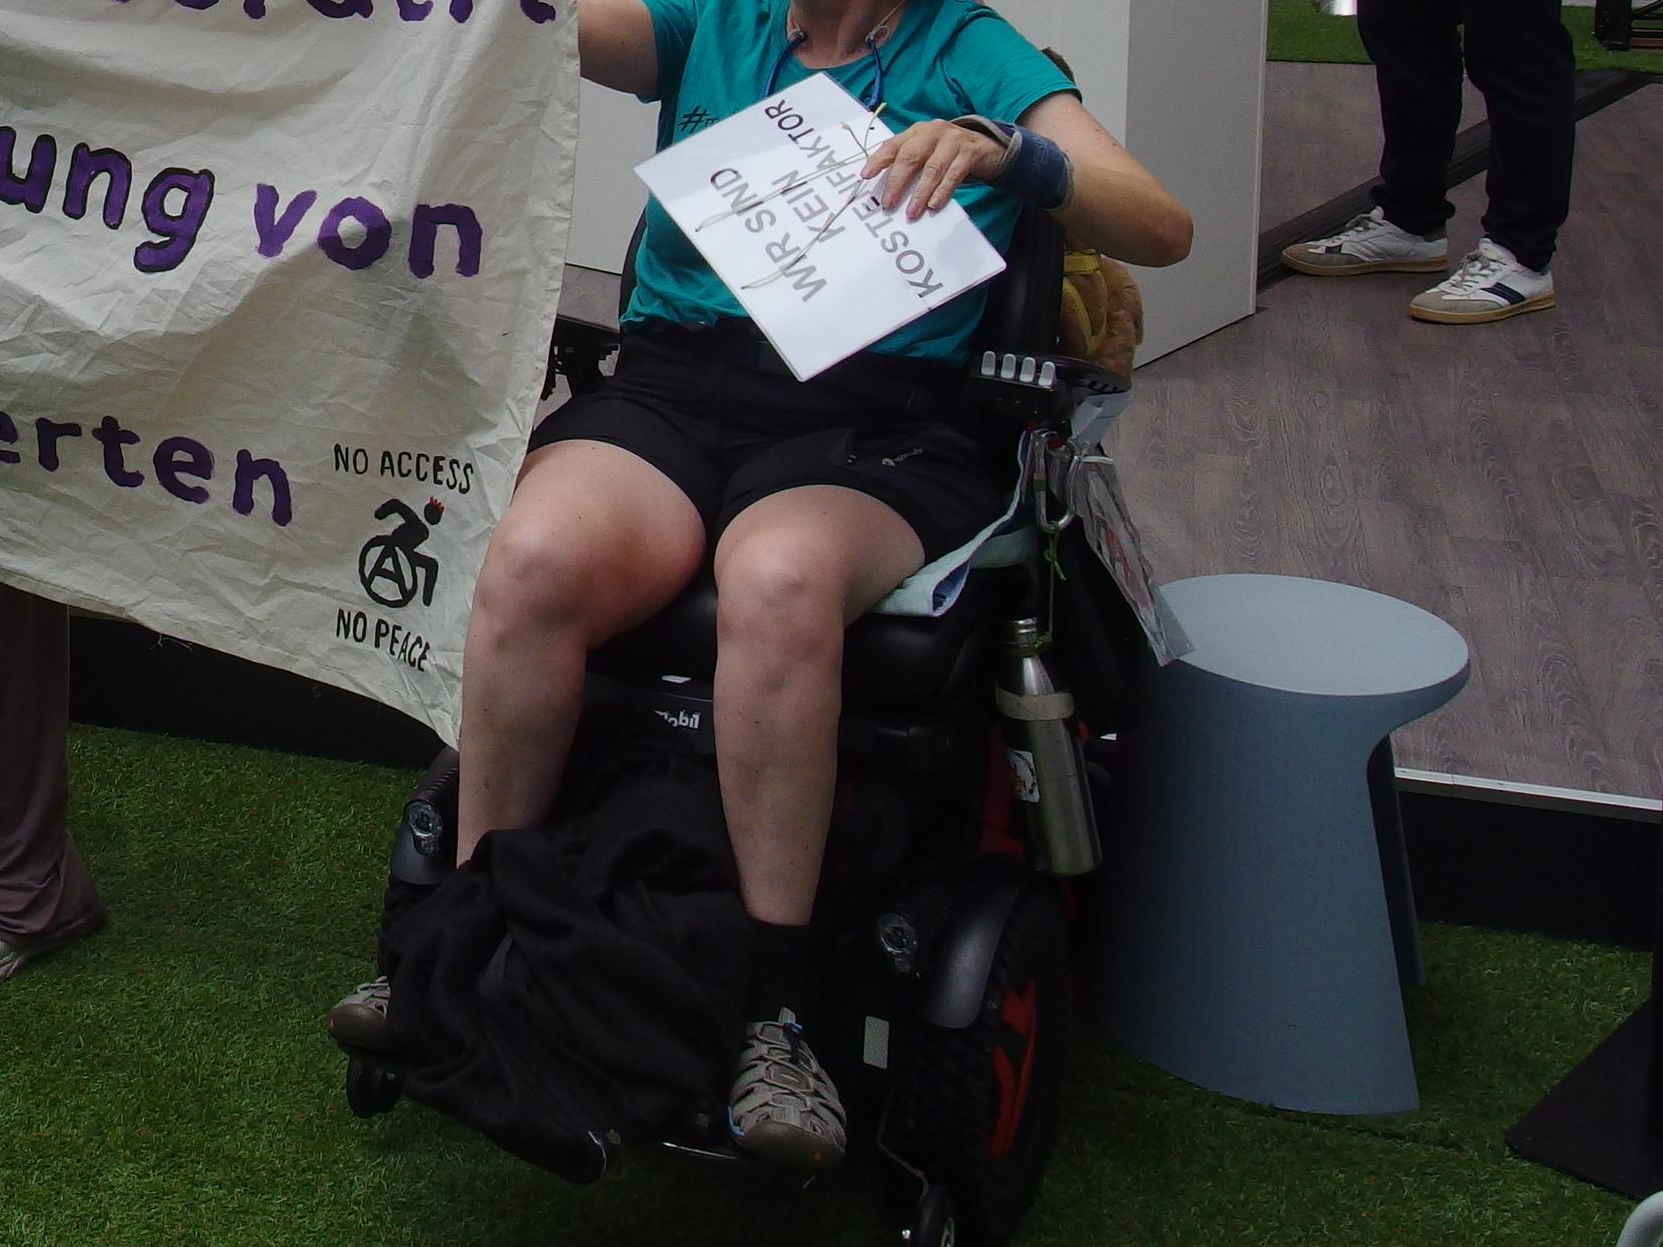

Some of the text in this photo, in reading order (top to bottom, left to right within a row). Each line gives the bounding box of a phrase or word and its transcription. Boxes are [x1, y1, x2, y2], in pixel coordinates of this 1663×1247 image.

[251, 181, 485, 279] von
[334, 442, 474, 494] NO ACCESS
[336, 608, 430, 673] NO PEACE
